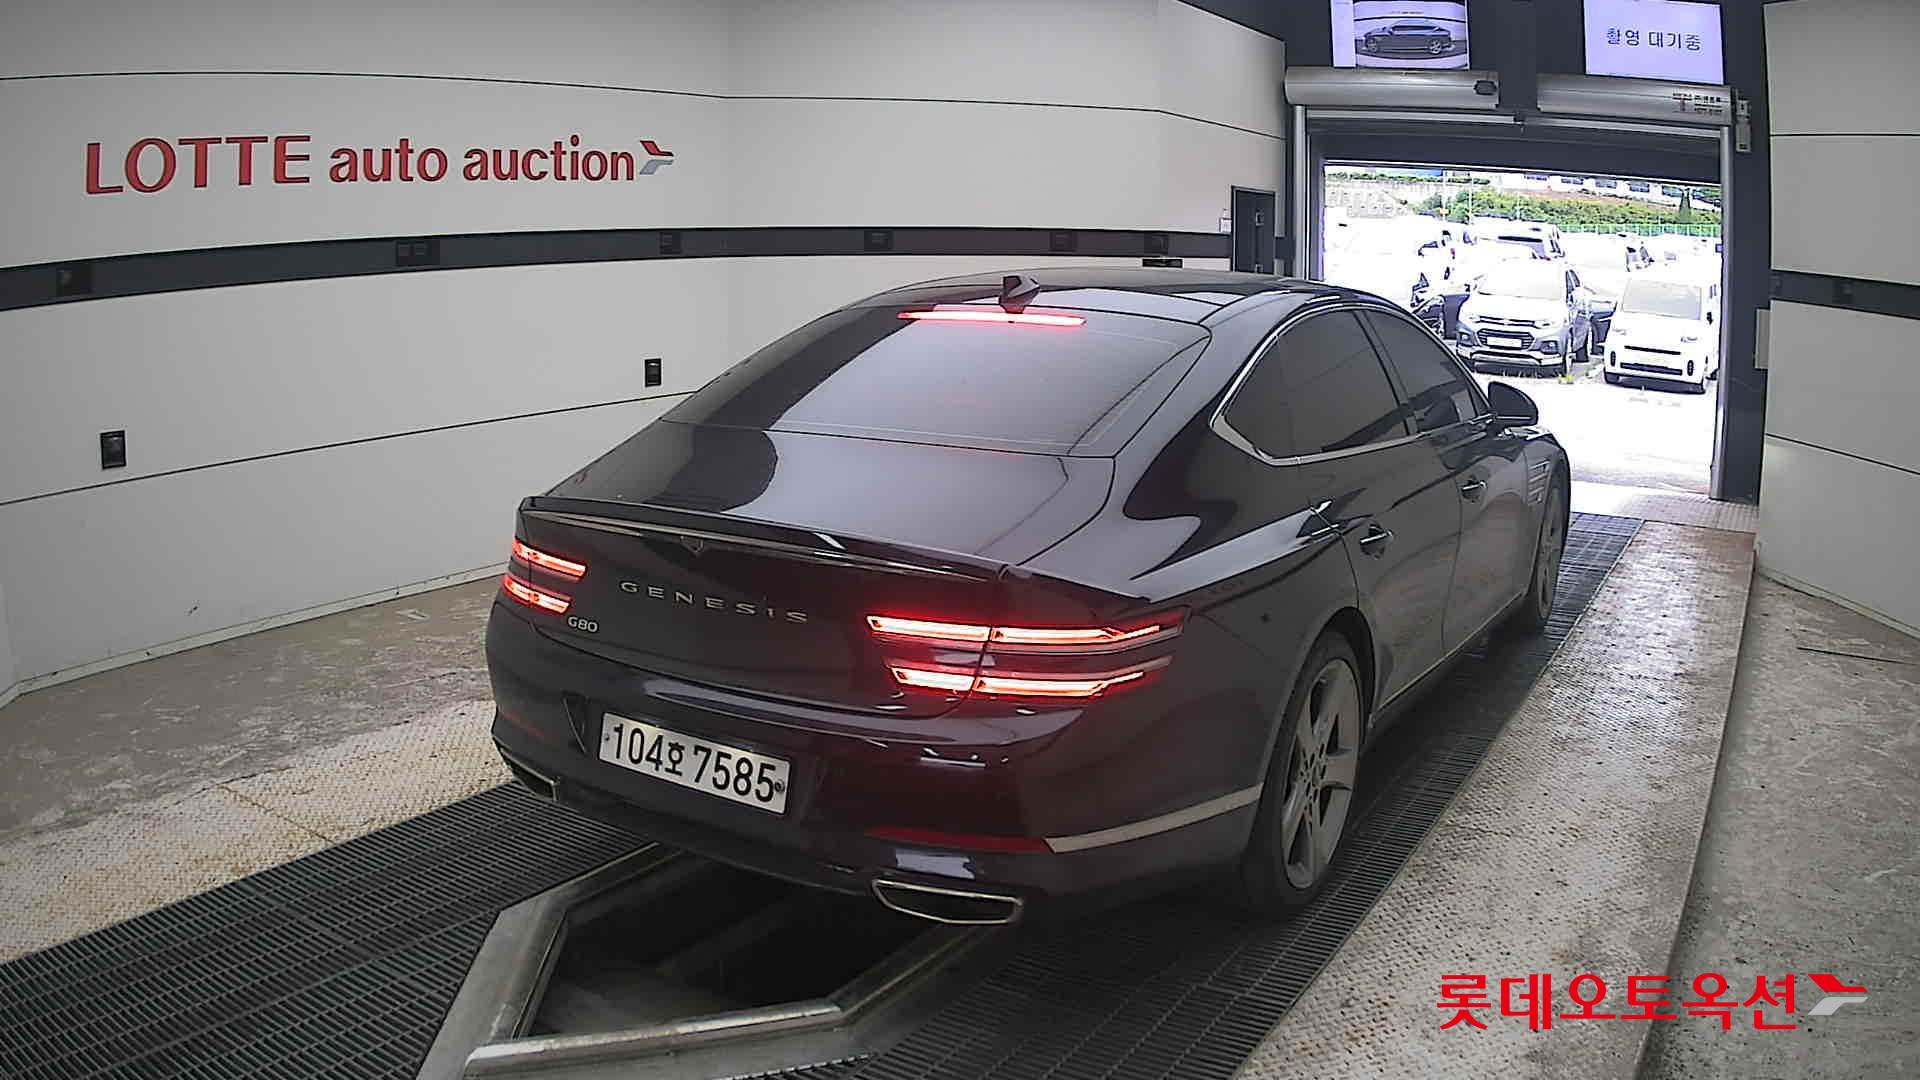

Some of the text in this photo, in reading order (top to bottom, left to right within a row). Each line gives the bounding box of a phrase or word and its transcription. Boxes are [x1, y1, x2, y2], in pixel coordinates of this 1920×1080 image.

[1648, 31, 1701, 51] 대기중
[86, 135, 636, 195] LOTTE auto auction
[620, 581, 808, 622] GENESIS
[567, 616, 599, 633] G80
[692, 744, 777, 803] 7585
